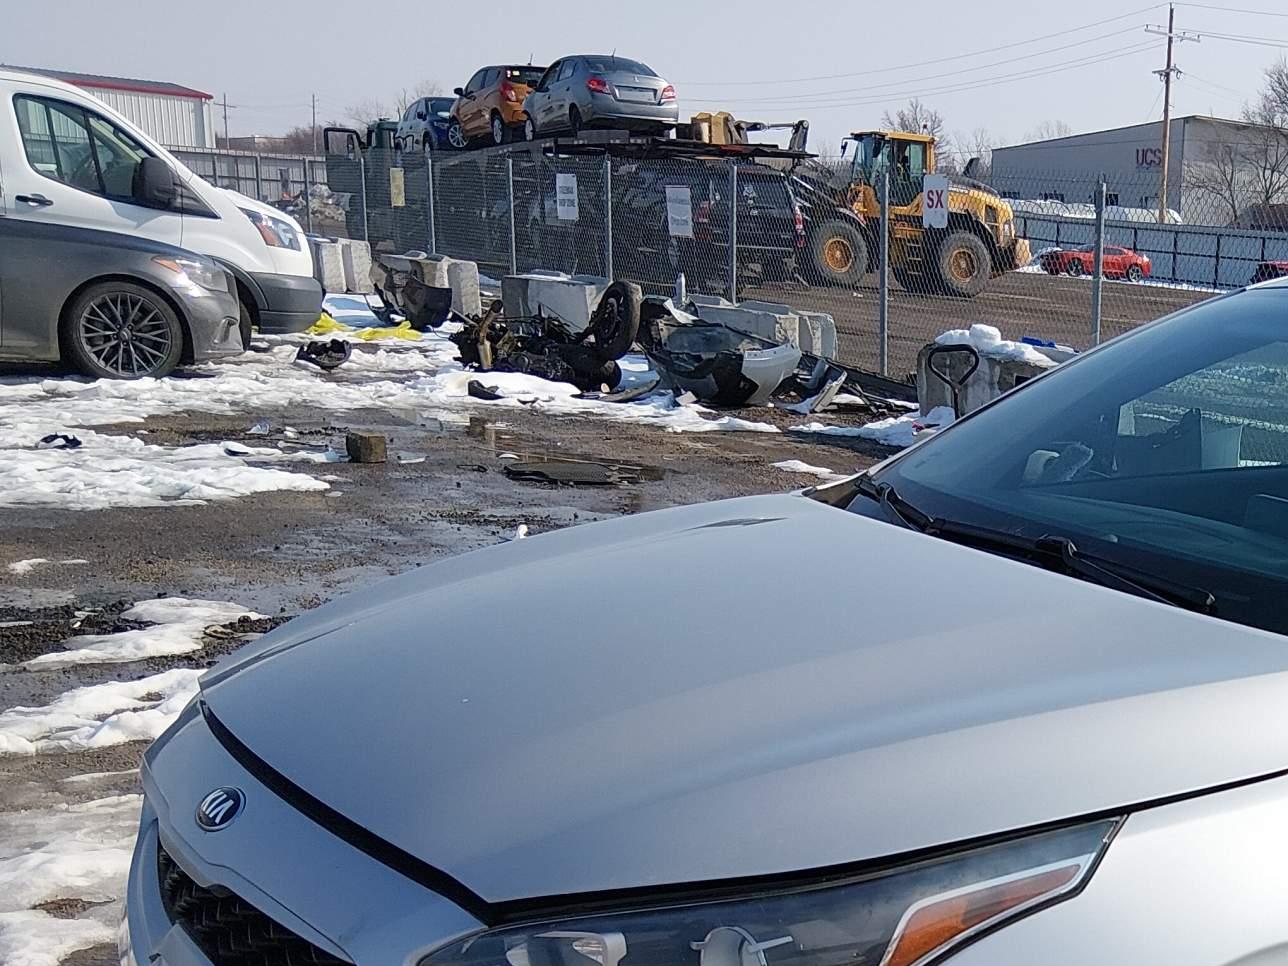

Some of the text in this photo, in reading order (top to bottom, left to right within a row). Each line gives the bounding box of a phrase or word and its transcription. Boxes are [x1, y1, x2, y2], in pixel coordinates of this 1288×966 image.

[1135, 148, 1162, 167] UCS
[926, 189, 944, 209] SX
[201, 789, 234, 825] KIA
